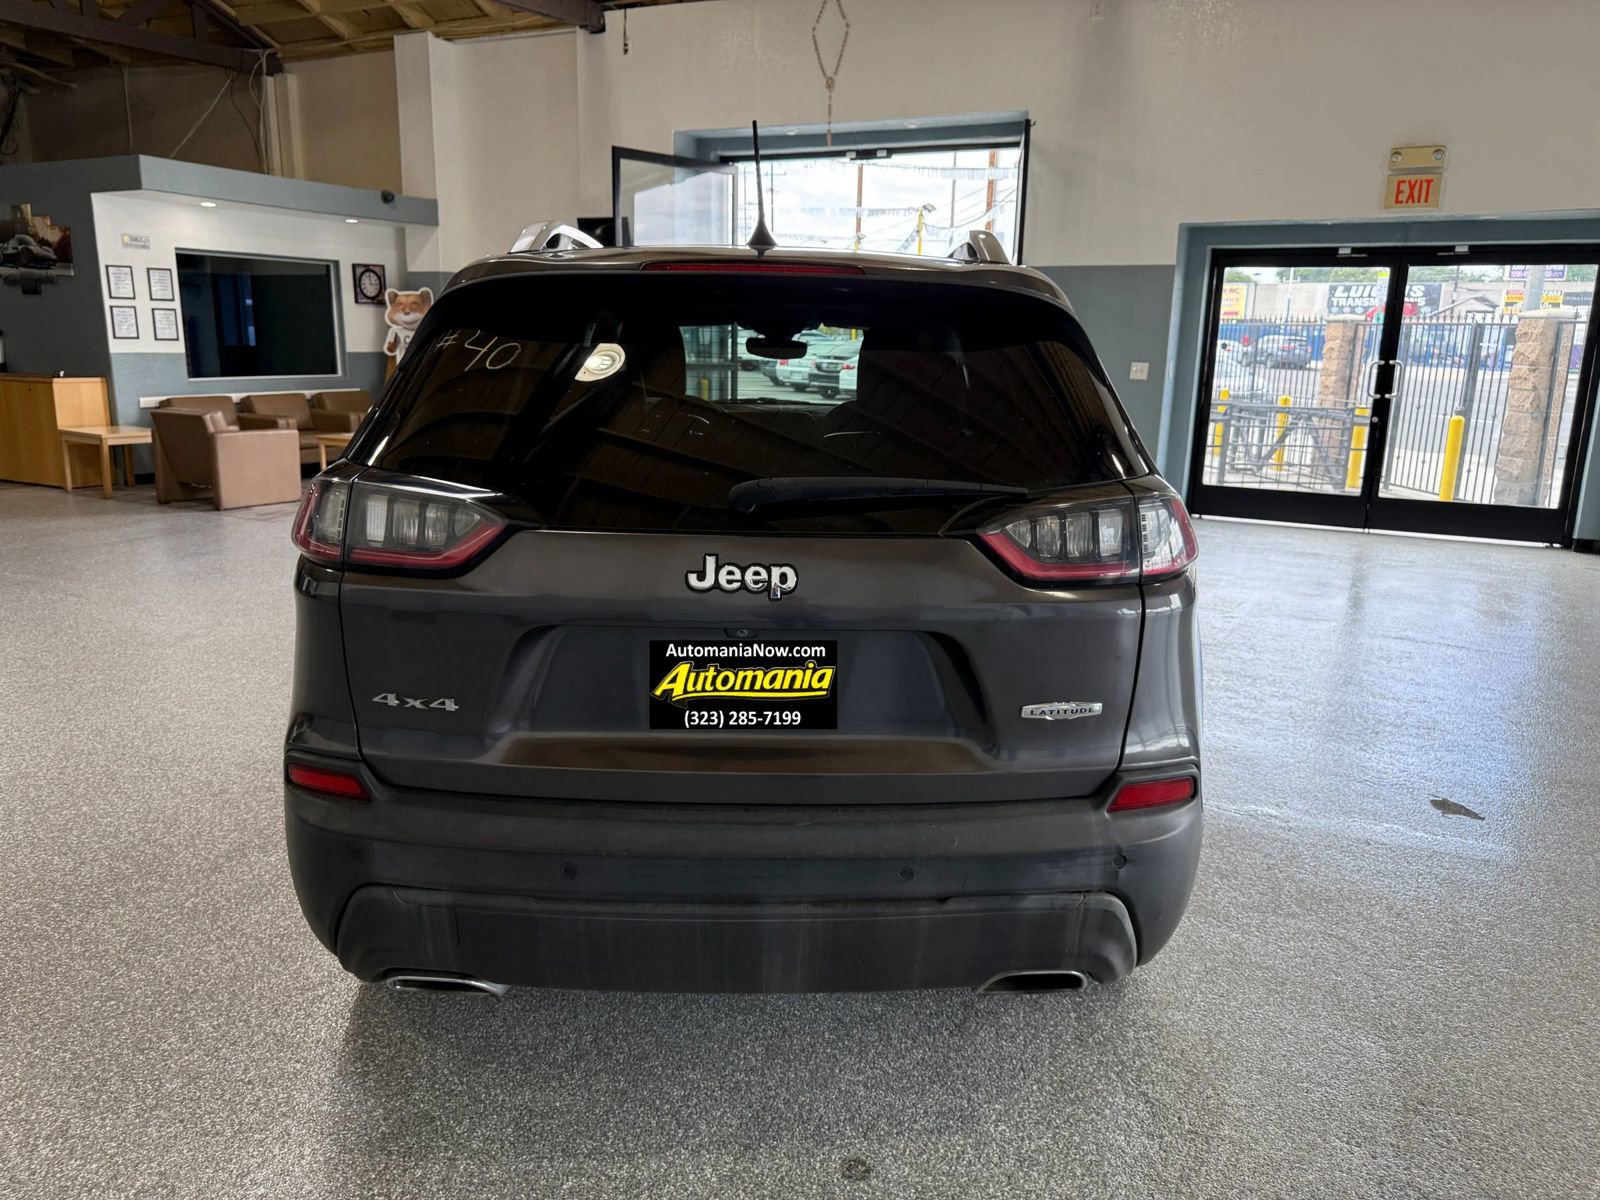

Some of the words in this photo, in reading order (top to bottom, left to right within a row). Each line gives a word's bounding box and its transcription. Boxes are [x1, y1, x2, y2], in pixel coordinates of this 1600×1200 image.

[1394, 178, 1434, 204] EXIT
[436, 329, 522, 372] #40
[686, 555, 798, 599] Jeep
[372, 693, 460, 712] 4x4
